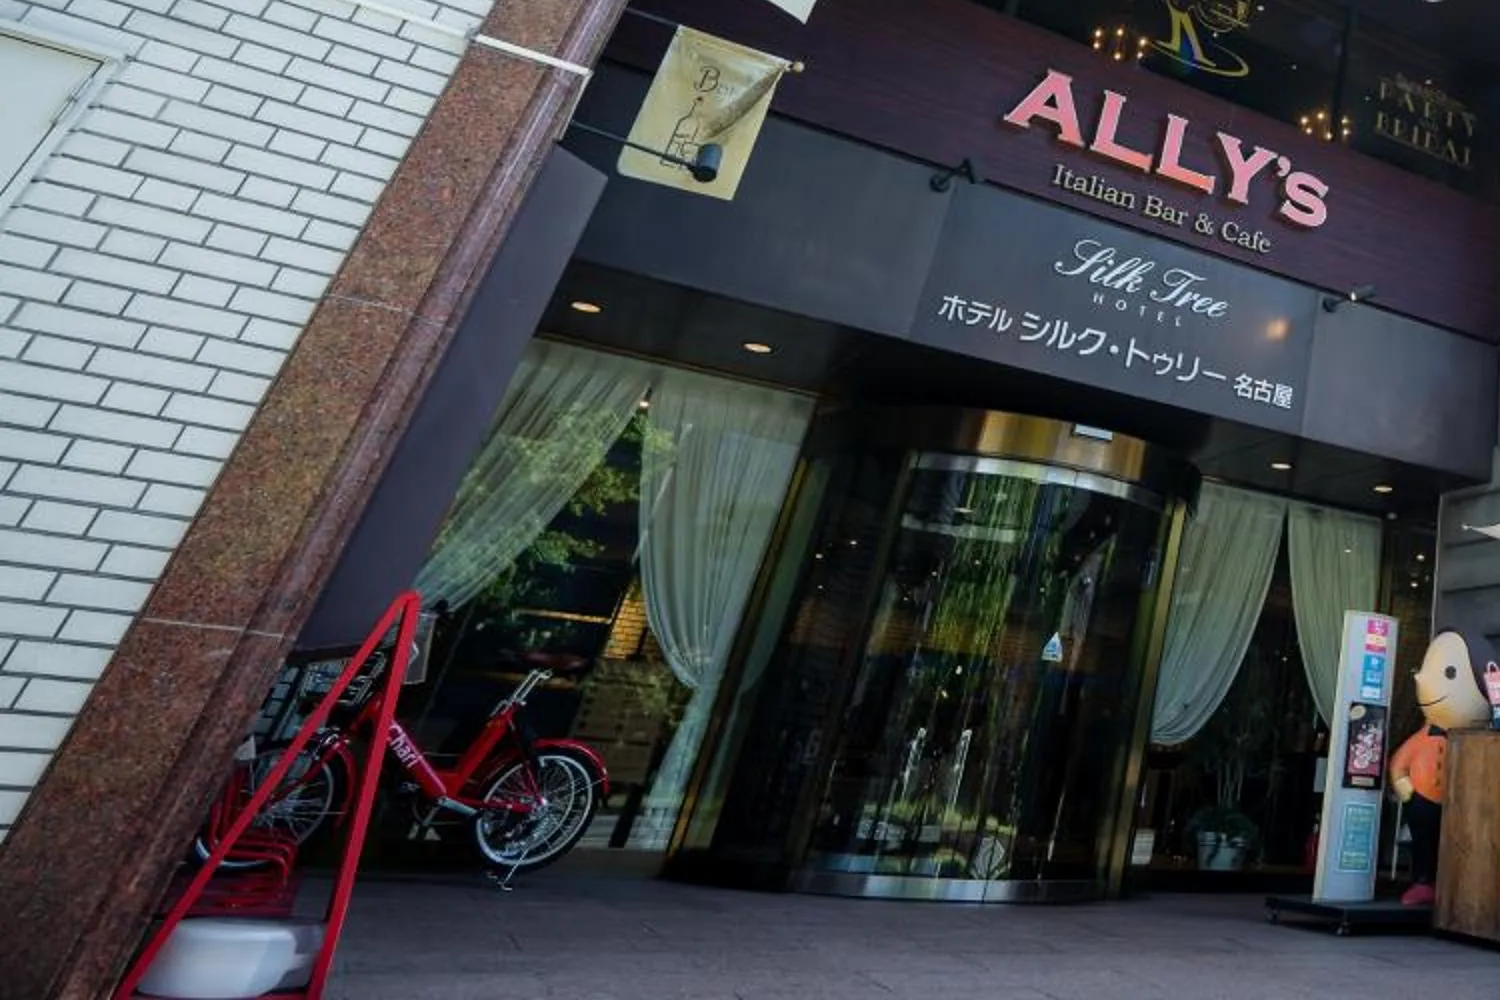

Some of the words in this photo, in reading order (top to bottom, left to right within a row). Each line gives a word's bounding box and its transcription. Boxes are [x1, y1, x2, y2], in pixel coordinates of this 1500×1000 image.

[1052, 164, 1135, 210] Italian
[1145, 196, 1188, 227] Bar
[1195, 213, 1214, 235] &
[1222, 222, 1272, 254] Cafe
[1055, 239, 1143, 295] Silk
[1152, 268, 1232, 319] Tree
[1093, 294, 1183, 328] HOTEL
[939, 296, 1012, 334] ホテル
[1021, 312, 1227, 383] シルク・トゥリー
[1234, 373, 1293, 409] 名古屋
